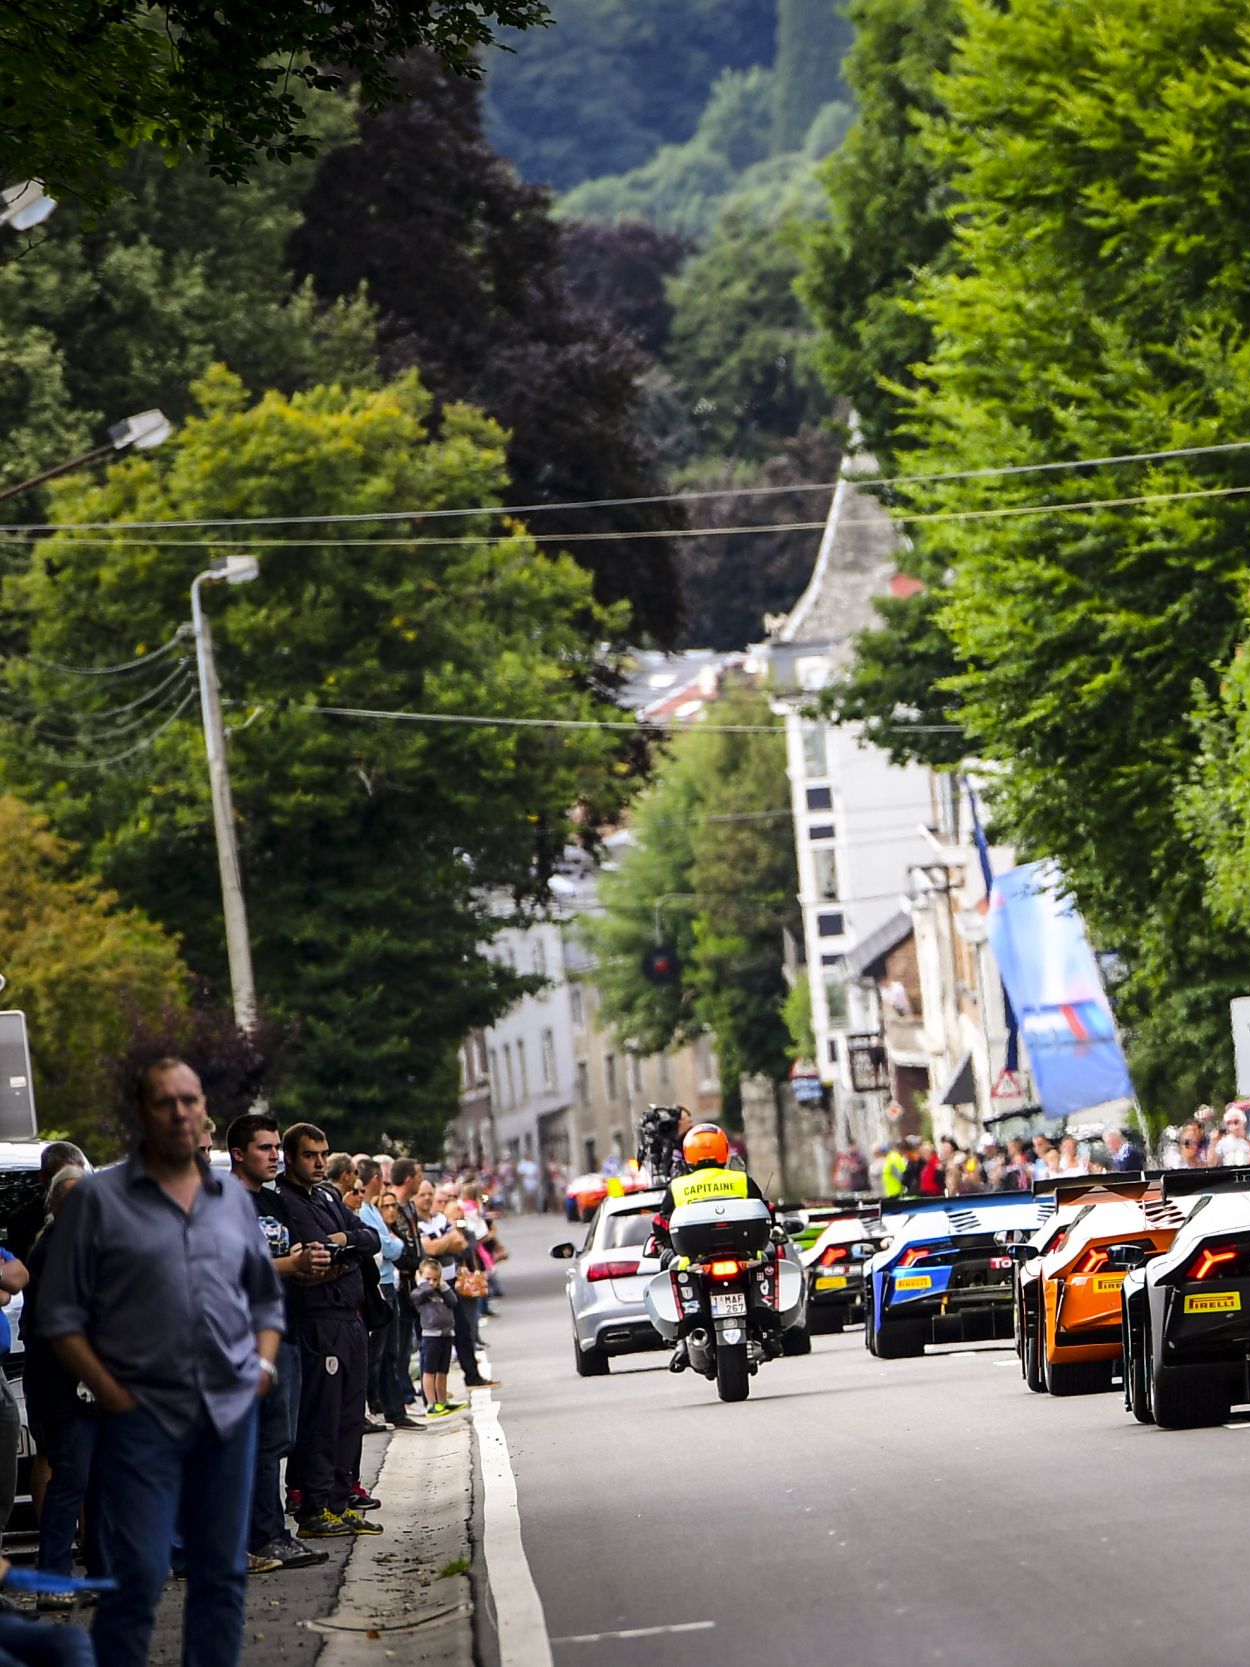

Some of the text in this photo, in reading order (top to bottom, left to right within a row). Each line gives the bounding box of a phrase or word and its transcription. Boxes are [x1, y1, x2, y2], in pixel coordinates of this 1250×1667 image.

[684, 1182, 735, 1196] CAPITAINE
[726, 1304, 744, 1313] 267
[1189, 1296, 1235, 1309] PIRELLI
